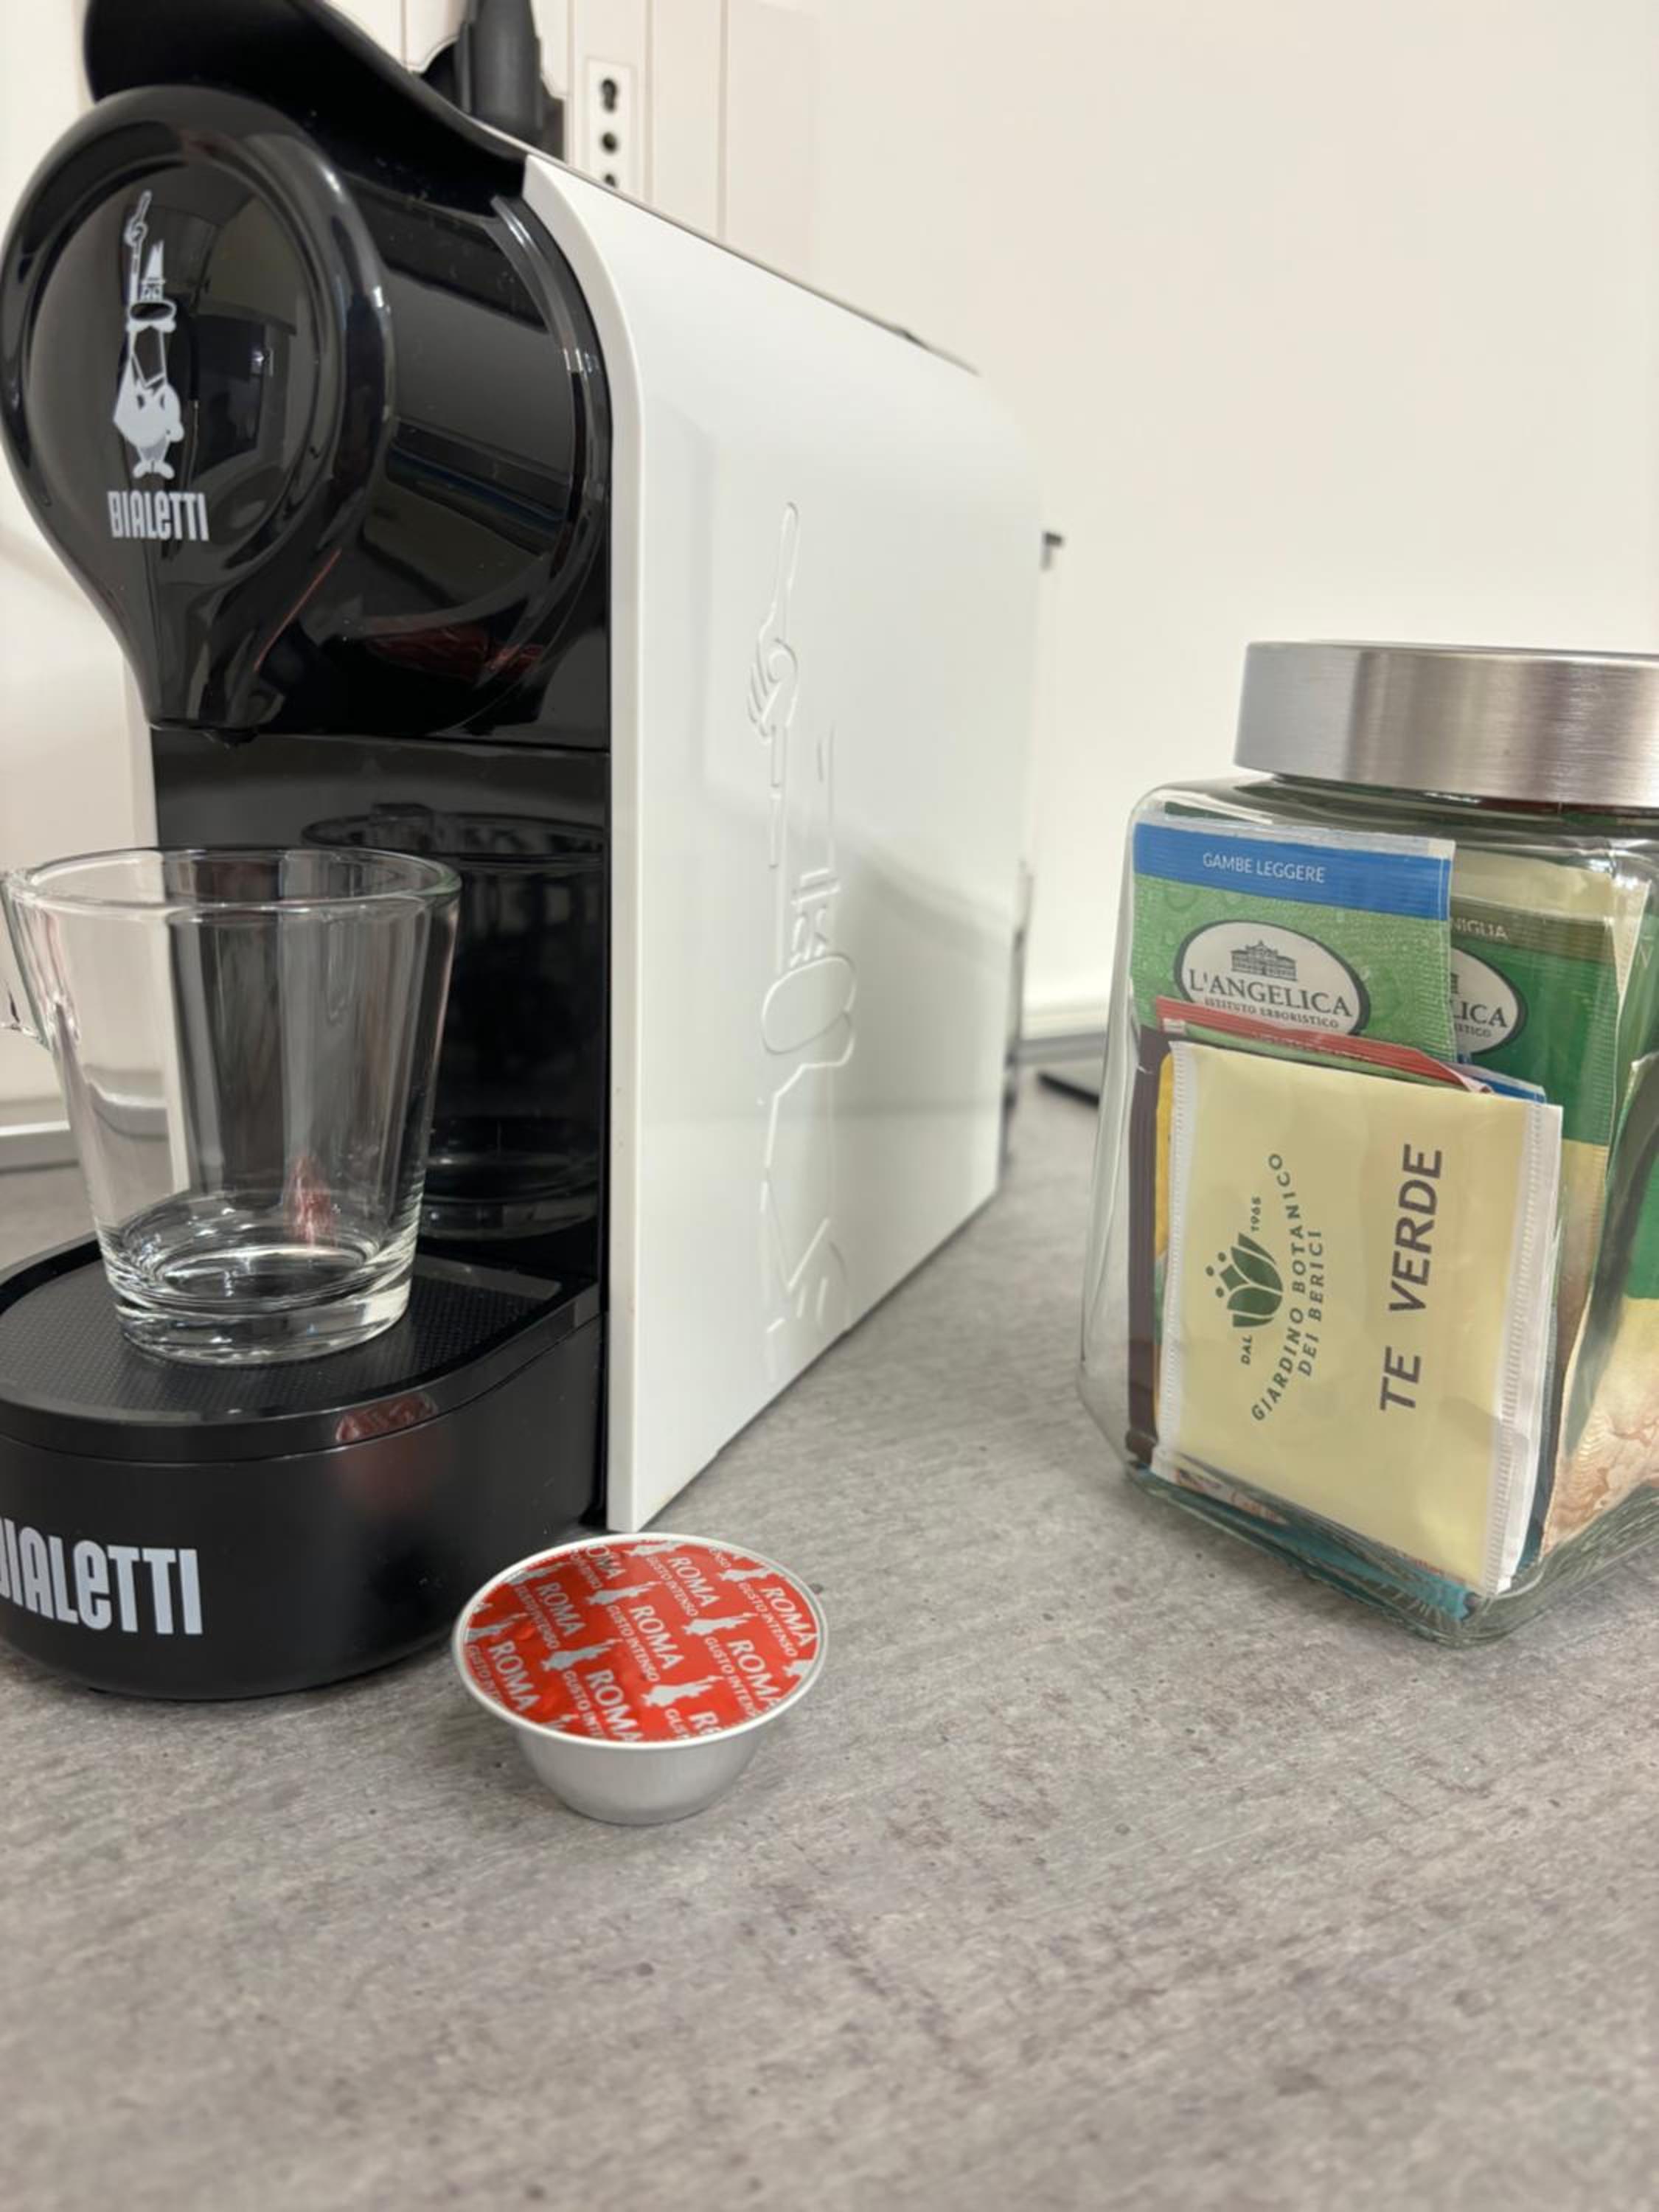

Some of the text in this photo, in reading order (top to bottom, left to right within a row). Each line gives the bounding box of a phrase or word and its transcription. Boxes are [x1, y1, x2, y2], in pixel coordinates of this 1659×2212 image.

[1203, 852, 1326, 883] GAMBE LEGGERE
[1189, 969, 1352, 1018] L'ANGELICA
[1204, 996, 1340, 1029] ISTITUTO ERBORISTICO
[1240, 1196, 1262, 1366] DAL 1965
[1251, 1153, 1307, 1422] GIARDINO BOTANICO
[1297, 1230, 1325, 1377] DEI BERICI
[1380, 1144, 1442, 1411] TE VERDE
[585, 1545, 626, 1579] OMA
[667, 1556, 720, 1607] ROMA
[535, 1582, 587, 1637] ROMA
[628, 1604, 685, 1670] ROMA
[759, 1587, 818, 1647] ROMA
[606, 1604, 661, 1683] GUSTO INTENSO
[704, 1636, 735, 1674] GUSTO
[490, 1640, 540, 1711] ROMA
[563, 1670, 591, 1711] GUSTO
